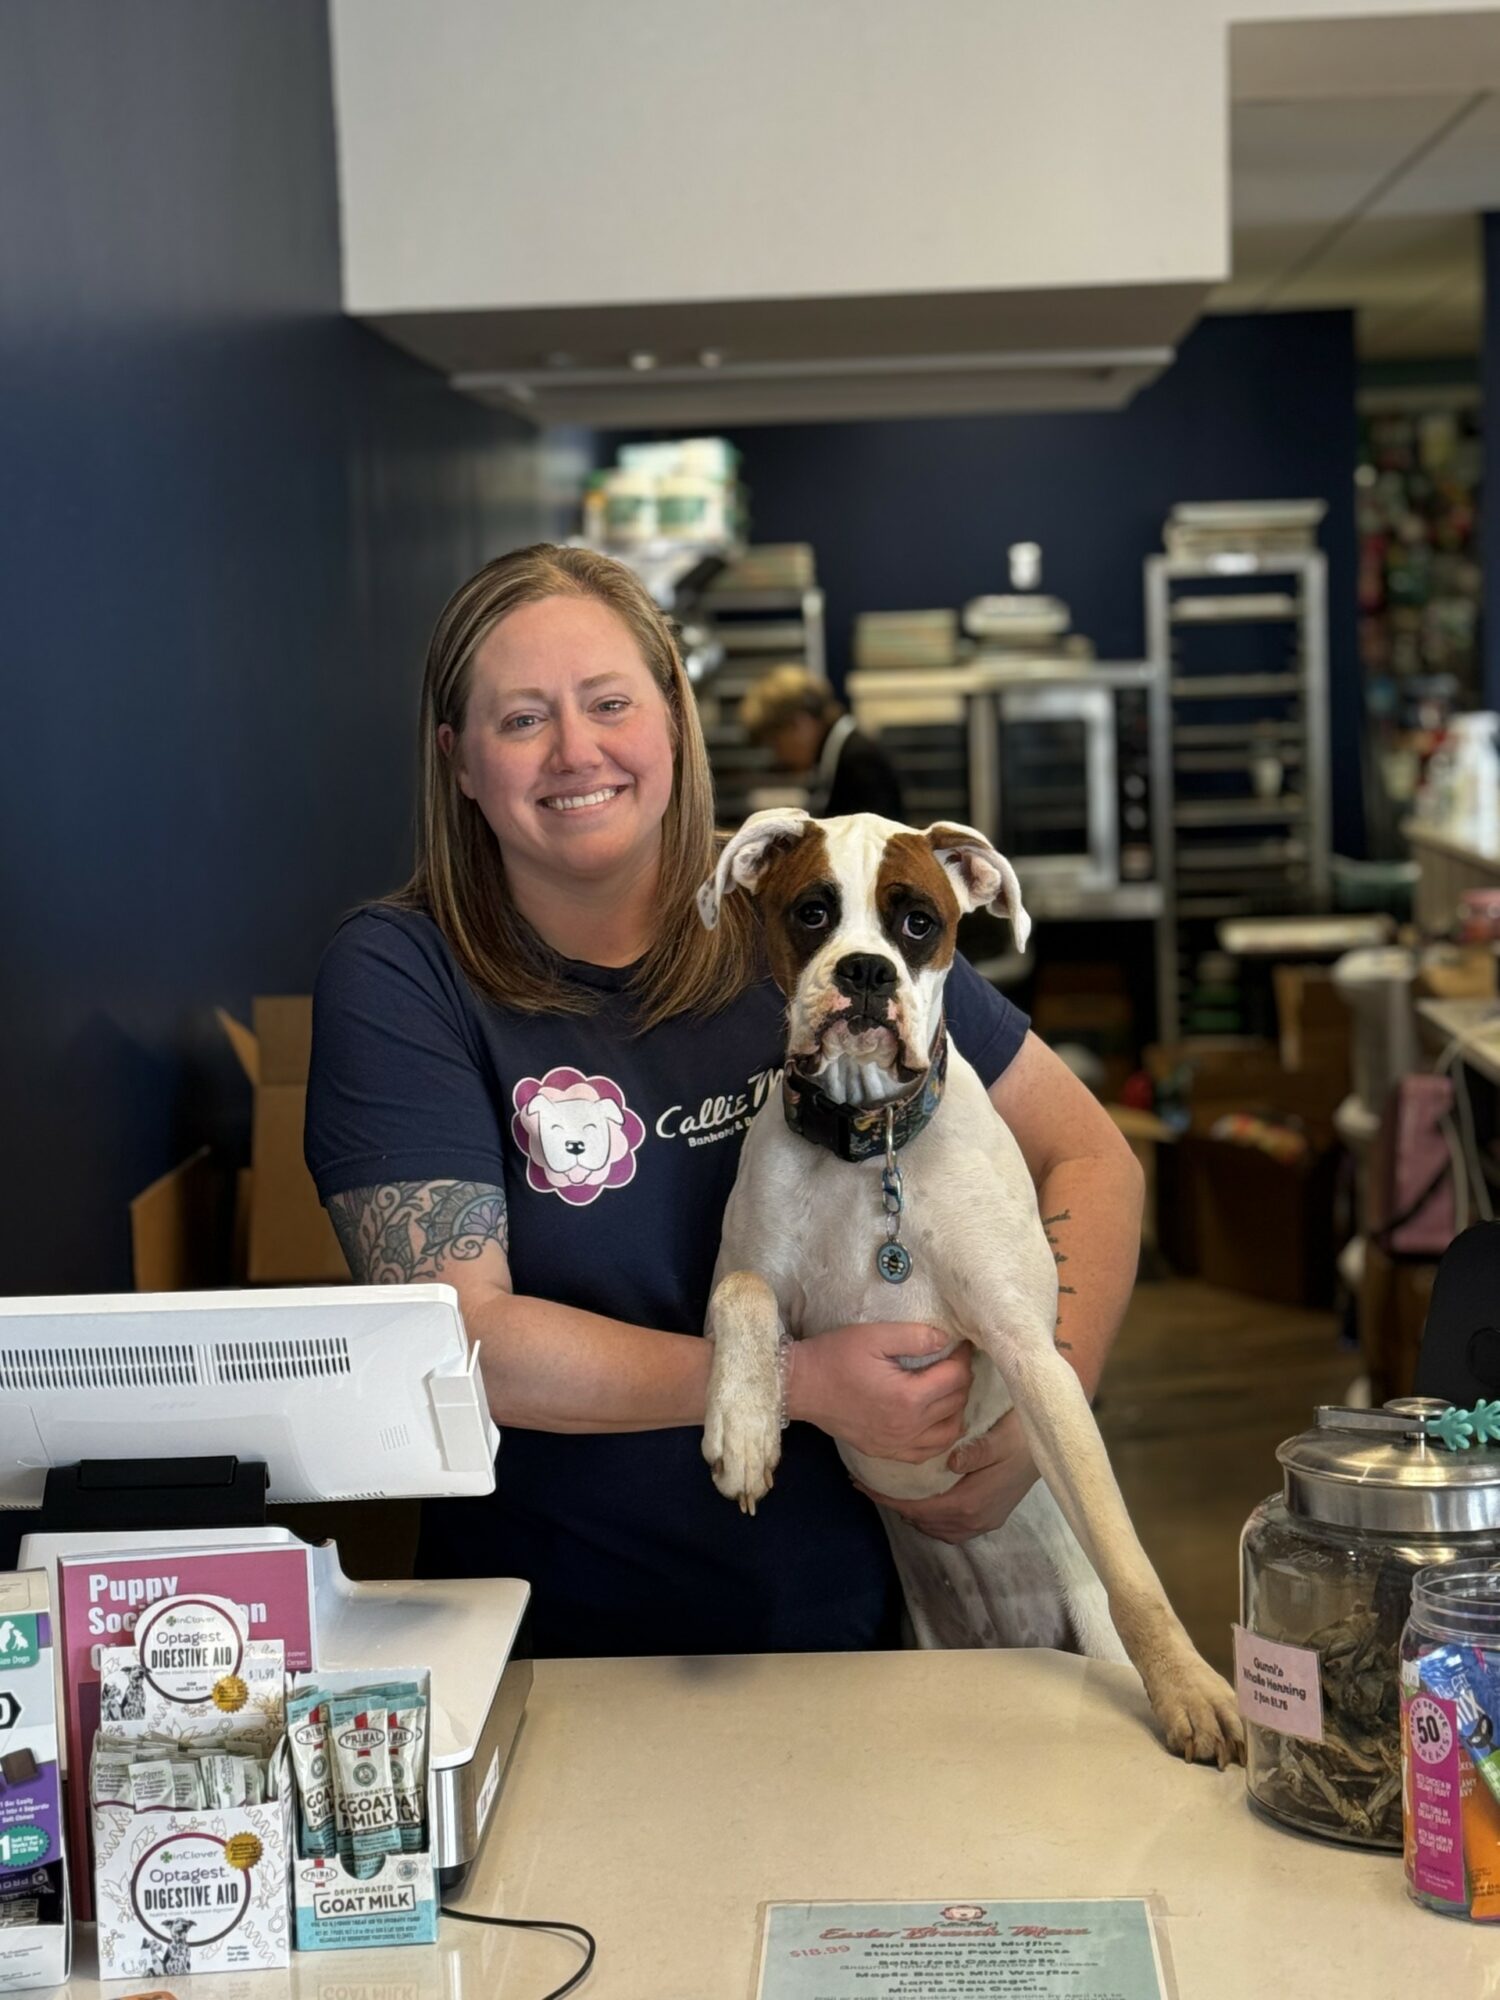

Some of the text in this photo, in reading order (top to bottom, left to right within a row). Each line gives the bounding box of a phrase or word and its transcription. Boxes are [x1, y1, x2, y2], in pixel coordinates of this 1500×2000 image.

[655, 1094, 748, 1139] Callie
[735, 1121, 743, 1131] &
[89, 1574, 178, 1605] Puppy
[151, 1646, 232, 1669] DIGESTIVE AID
[1266, 1677, 1307, 1701] Herring
[344, 1731, 381, 1745] PRIMAL
[1416, 1714, 1441, 1745] 50
[1416, 1737, 1451, 1761] TREATS
[348, 1793, 393, 1814] GOAT
[351, 1808, 394, 1829] MILK
[173, 1850, 219, 1860] inClover
[144, 1882, 238, 1910] DIGESTIVE AID
[334, 1885, 394, 1896] DEHYDRATED
[319, 1892, 410, 1914] GOAT MILK
[819, 1926, 1092, 1940] Easter Brunch Menu
[789, 1944, 851, 1958] $18.99
